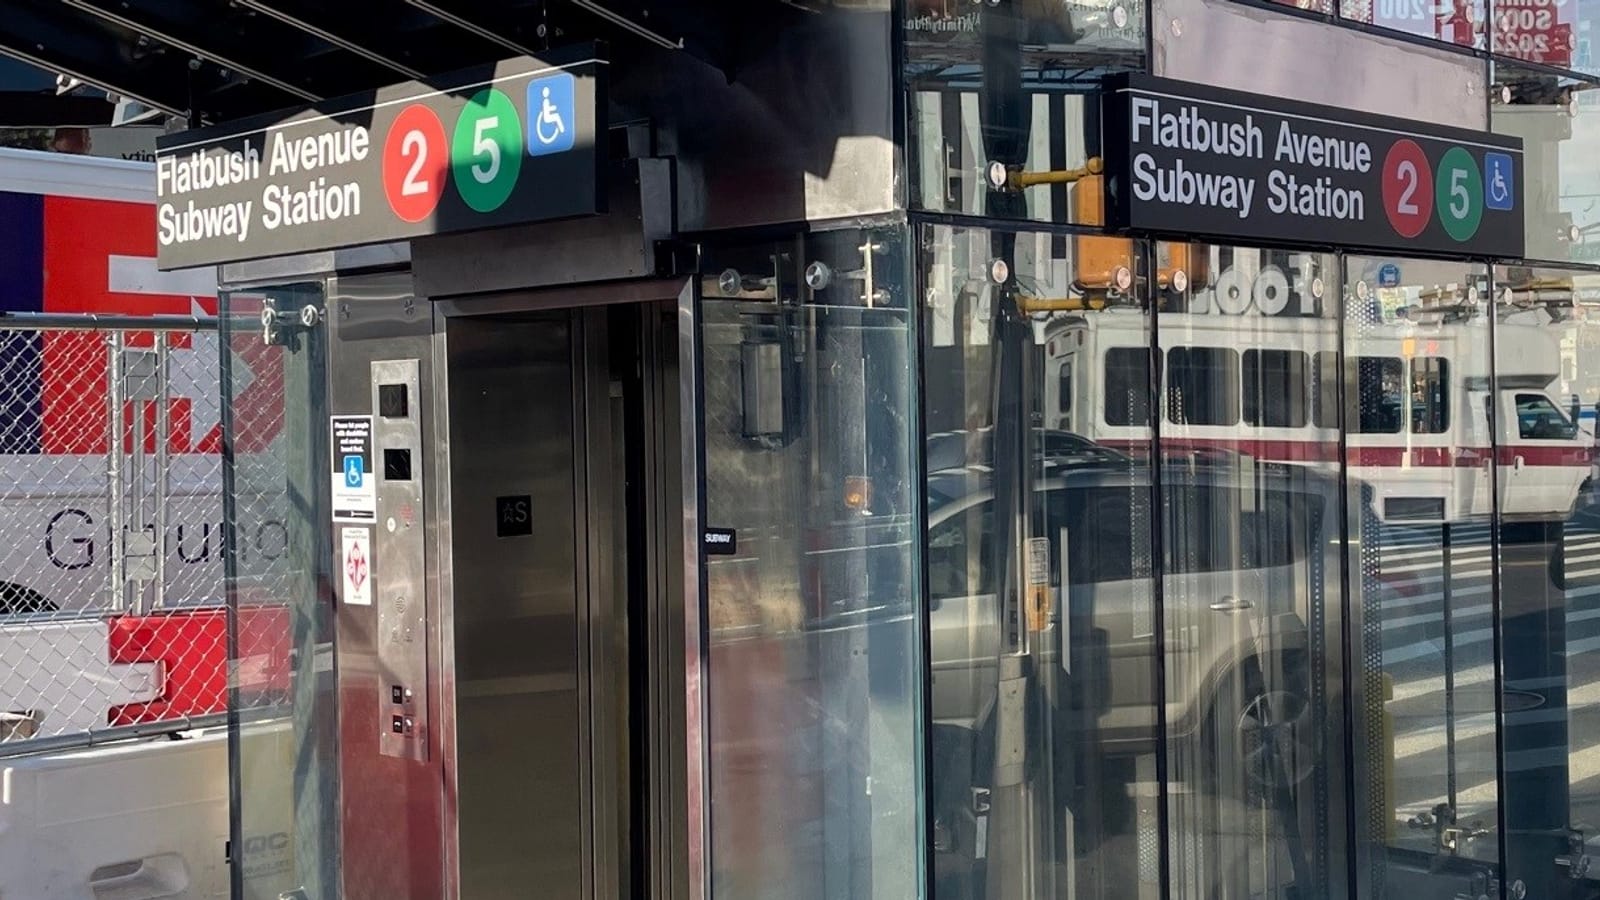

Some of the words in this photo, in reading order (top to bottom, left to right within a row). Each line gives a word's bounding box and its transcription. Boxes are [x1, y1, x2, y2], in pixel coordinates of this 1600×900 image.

[157, 139, 260, 196] Flatbush
[269, 126, 369, 176] Avenue
[401, 129, 429, 196] 2
[471, 116, 501, 184] 5
[1132, 96, 1264, 159] Flatbush
[1274, 120, 1372, 173] Avenue
[158, 200, 252, 246] Subway
[262, 177, 361, 230] Station
[1132, 153, 1256, 219] Subway
[1267, 169, 1365, 221] Station
[1397, 160, 1419, 215] 2
[1450, 168, 1469, 219] 5
[705, 533, 731, 543] SUBWAY
